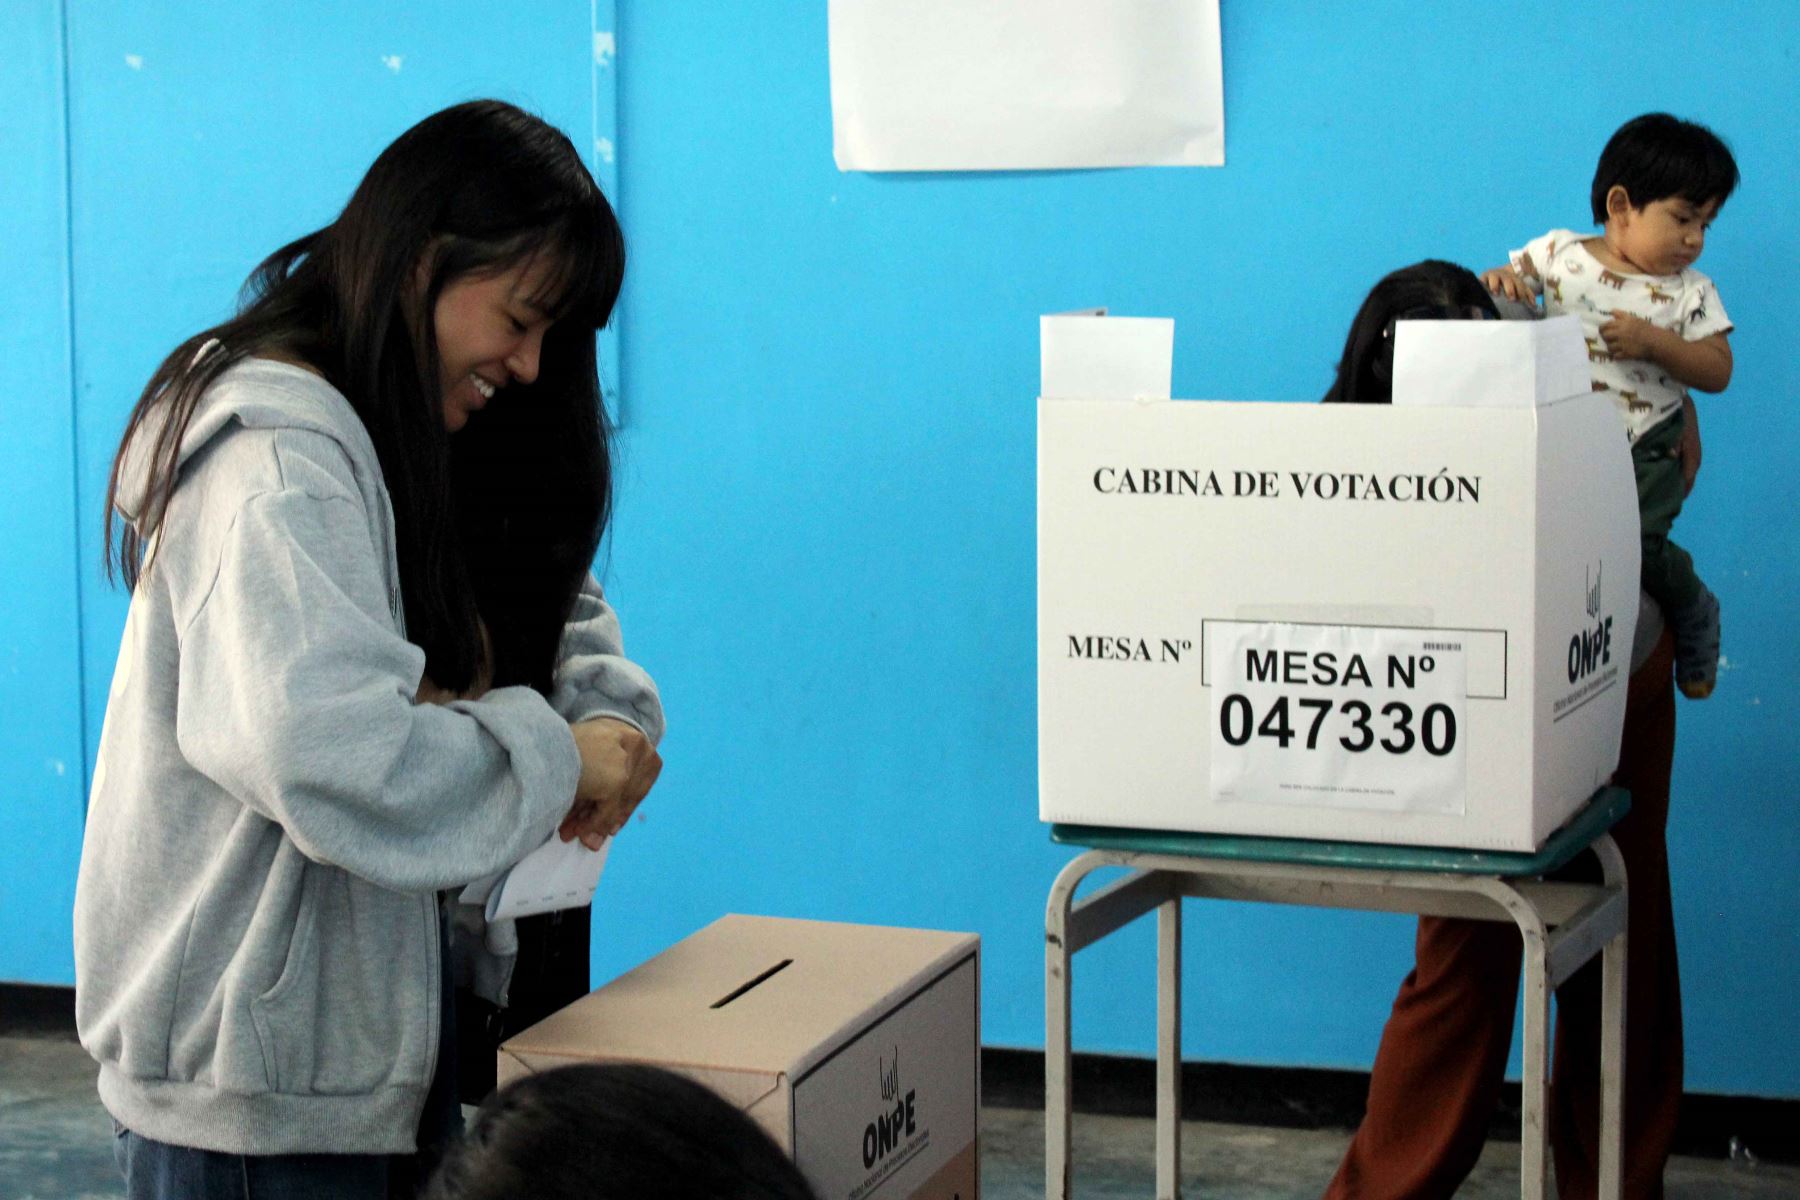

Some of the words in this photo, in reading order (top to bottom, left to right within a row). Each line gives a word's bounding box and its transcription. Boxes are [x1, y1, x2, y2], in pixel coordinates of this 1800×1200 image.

[1092, 468, 1222, 497] CABINA
[1233, 471, 1279, 498] DE
[1289, 467, 1482, 504] VOTACIÓN
[1068, 635, 1153, 662] MESA
[1159, 639, 1192, 663] Nº
[1246, 649, 1373, 687] MESA
[1387, 655, 1436, 689] Nº
[1568, 615, 1613, 684] ONPE
[1219, 693, 1457, 756] 047330
[863, 1087, 916, 1170] ONPE
